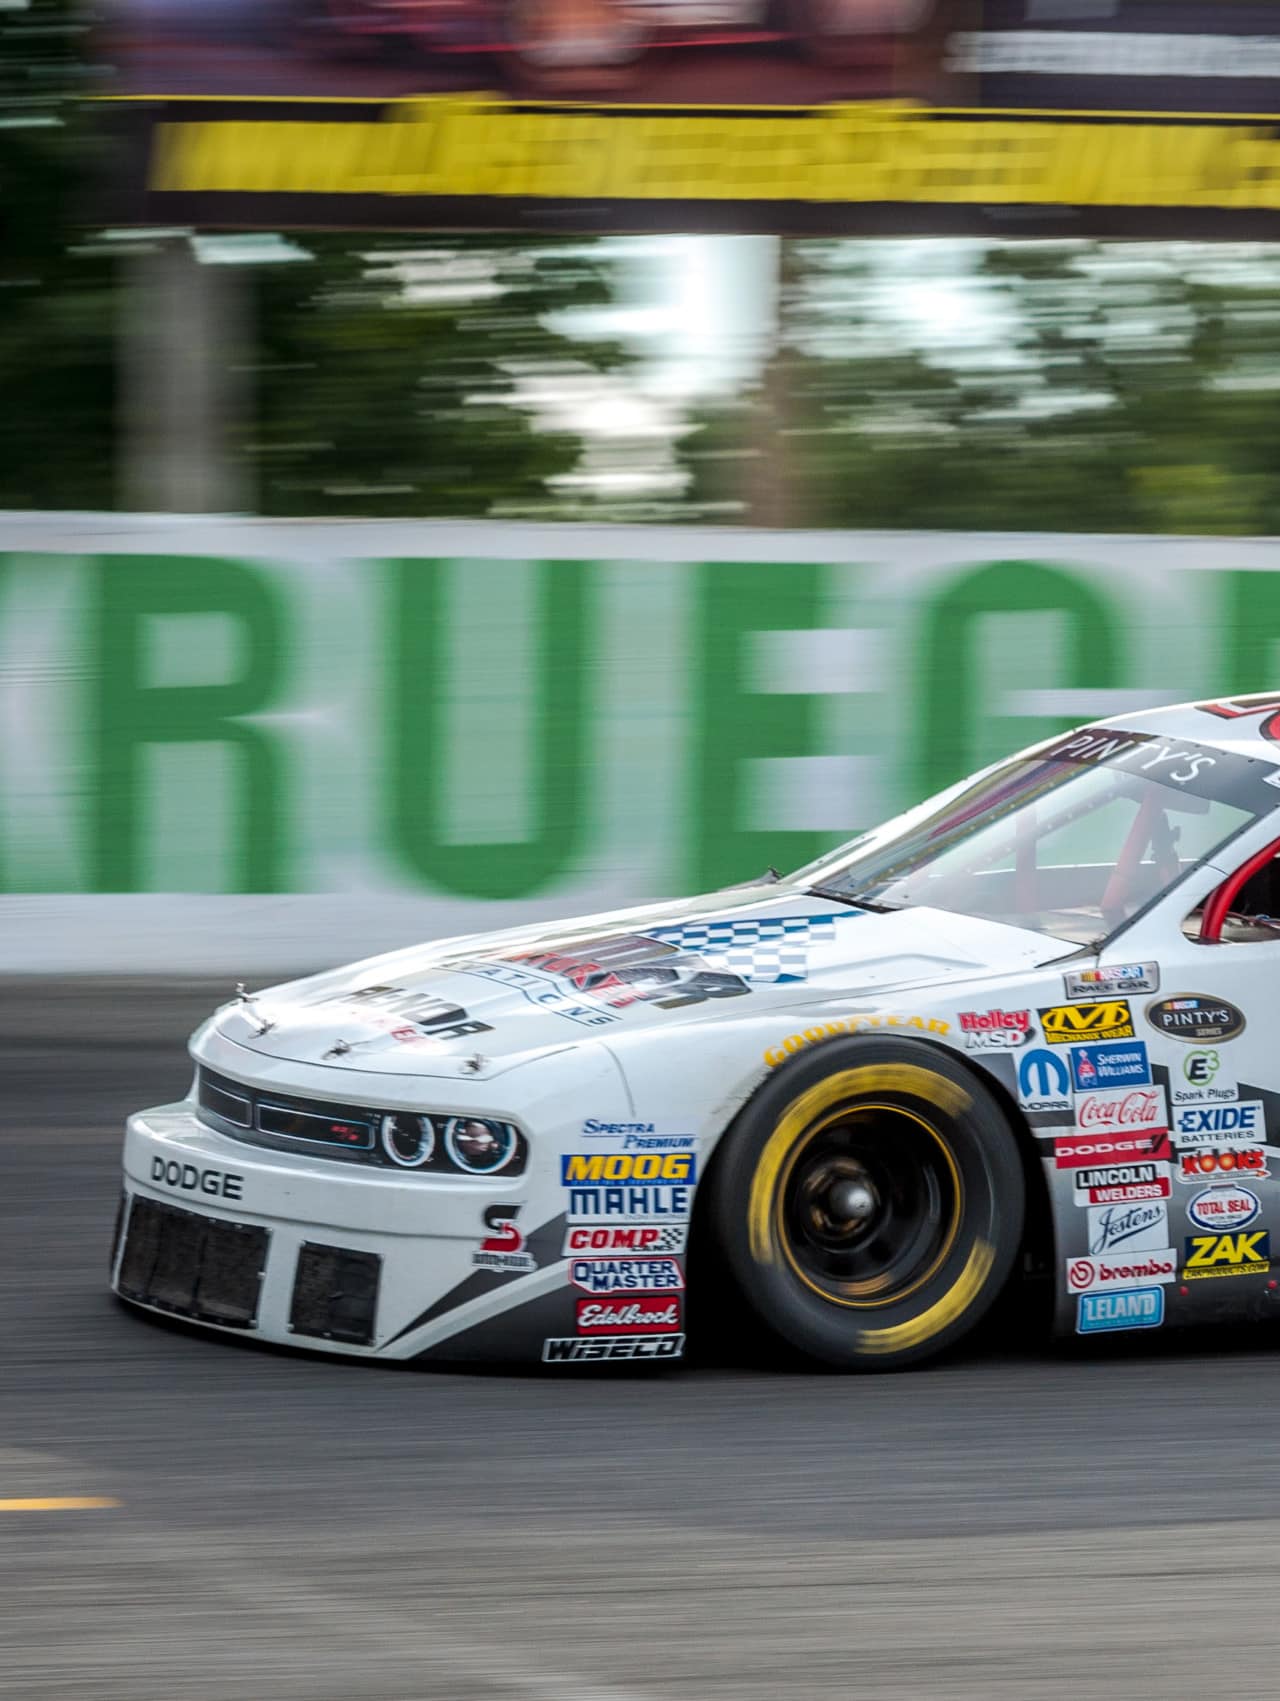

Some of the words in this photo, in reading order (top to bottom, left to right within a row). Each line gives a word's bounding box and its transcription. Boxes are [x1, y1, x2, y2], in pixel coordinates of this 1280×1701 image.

[1051, 735, 1217, 782] PINTY'S
[1072, 984, 1113, 993] RACE
[1117, 981, 1151, 990] CAR
[957, 1009, 1030, 1033] Holley
[1162, 1009, 1230, 1027] PINTY'S
[762, 1015, 952, 1067] GOODYEAR
[966, 1030, 1026, 1048] MSD
[1097, 1052, 1141, 1065] SHERWIN
[1175, 1091, 1203, 1102] Spark
[1206, 1088, 1236, 1101] Plugs
[1079, 1091, 1161, 1128] Coca-Cola
[1178, 1106, 1257, 1132] EXIDE
[583, 1119, 655, 1134] SPECTRA
[622, 1134, 694, 1149] PREMIUM
[1181, 1131, 1256, 1144] BATTERIES
[1055, 1140, 1154, 1157] DODGE
[565, 1154, 692, 1180] MOOG
[1078, 1166, 1154, 1187] LINCOLN
[151, 1156, 244, 1200] DODGE
[1096, 1184, 1163, 1201] WELDERS
[1196, 1201, 1225, 1215] TOTAL
[1227, 1199, 1252, 1213] SEAL
[569, 1229, 659, 1249] COMP
[1089, 1204, 1166, 1256] Jostens
[1186, 1231, 1268, 1267] ZAK
[574, 1260, 674, 1282] QUARTER
[1099, 1259, 1173, 1281] brembo
[593, 1273, 679, 1291] MASTER
[577, 1303, 679, 1327] Edelbrock
[1087, 1293, 1156, 1320] LELAND
[545, 1334, 685, 1361] WISECO
